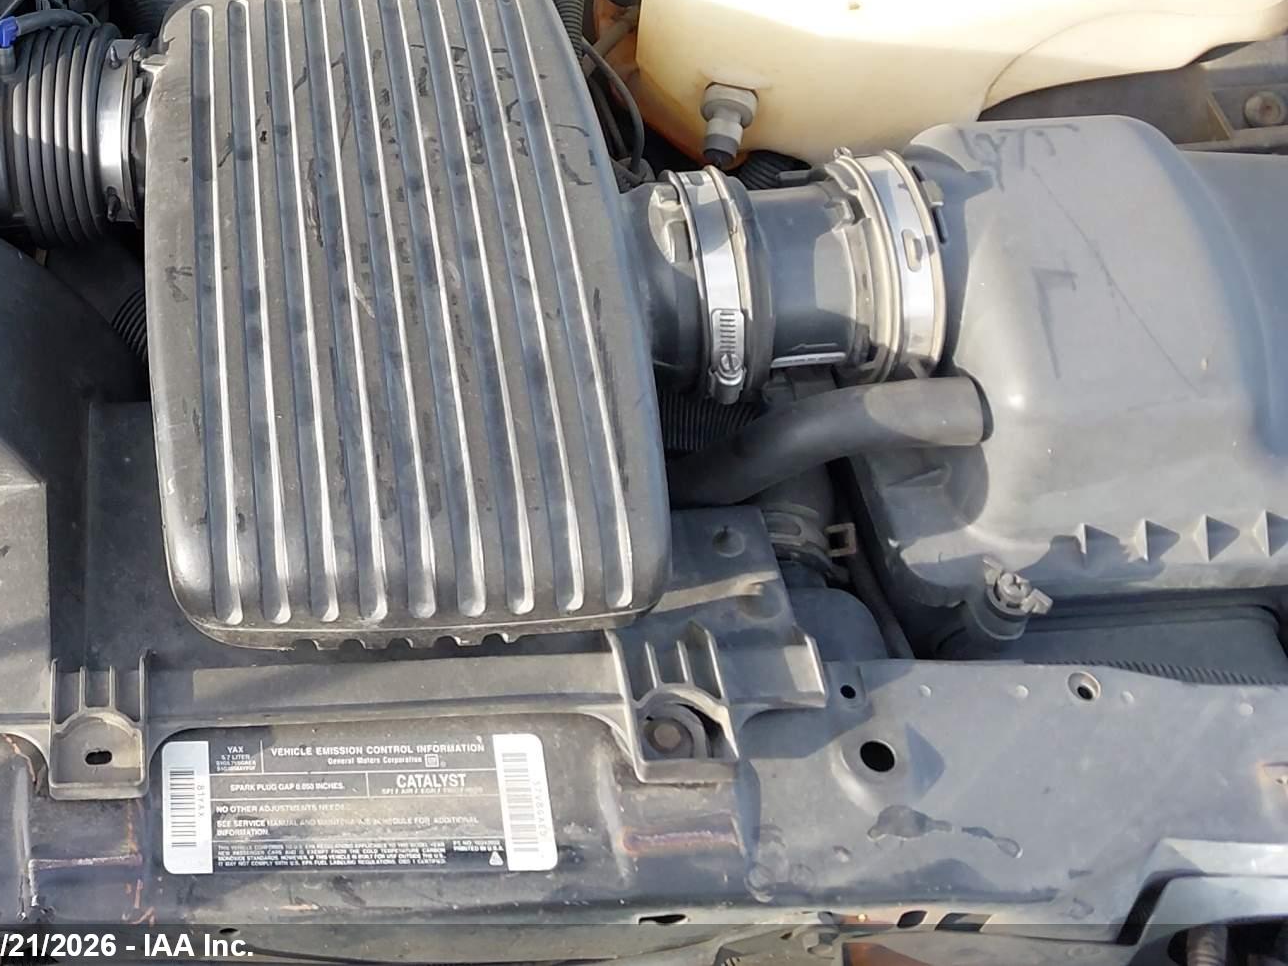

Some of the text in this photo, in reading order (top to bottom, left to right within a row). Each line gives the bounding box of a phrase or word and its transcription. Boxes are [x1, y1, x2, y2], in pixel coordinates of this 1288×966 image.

[227, 745, 244, 754] YAX
[271, 743, 485, 756] VEHICLE EMISSION CONTROL INFORMATION
[327, 757, 355, 765] General
[356, 756, 380, 764] Motors
[382, 755, 423, 764] Corporation
[396, 773, 466, 788] CATALYST
[230, 784, 256, 792] SPARK
[256, 783, 277, 791] PLUG
[278, 783, 294, 791] GAP
[216, 804, 317, 813] NO OTHER ADJUSTMENTS
[217, 819, 232, 828] SEE
[233, 819, 266, 827] SERVICE
[267, 819, 298, 827] MANUAL
[300, 819, 316, 827] AND
[414, 817, 430, 826] FOR
[433, 817, 480, 825] ADDITIONAL
